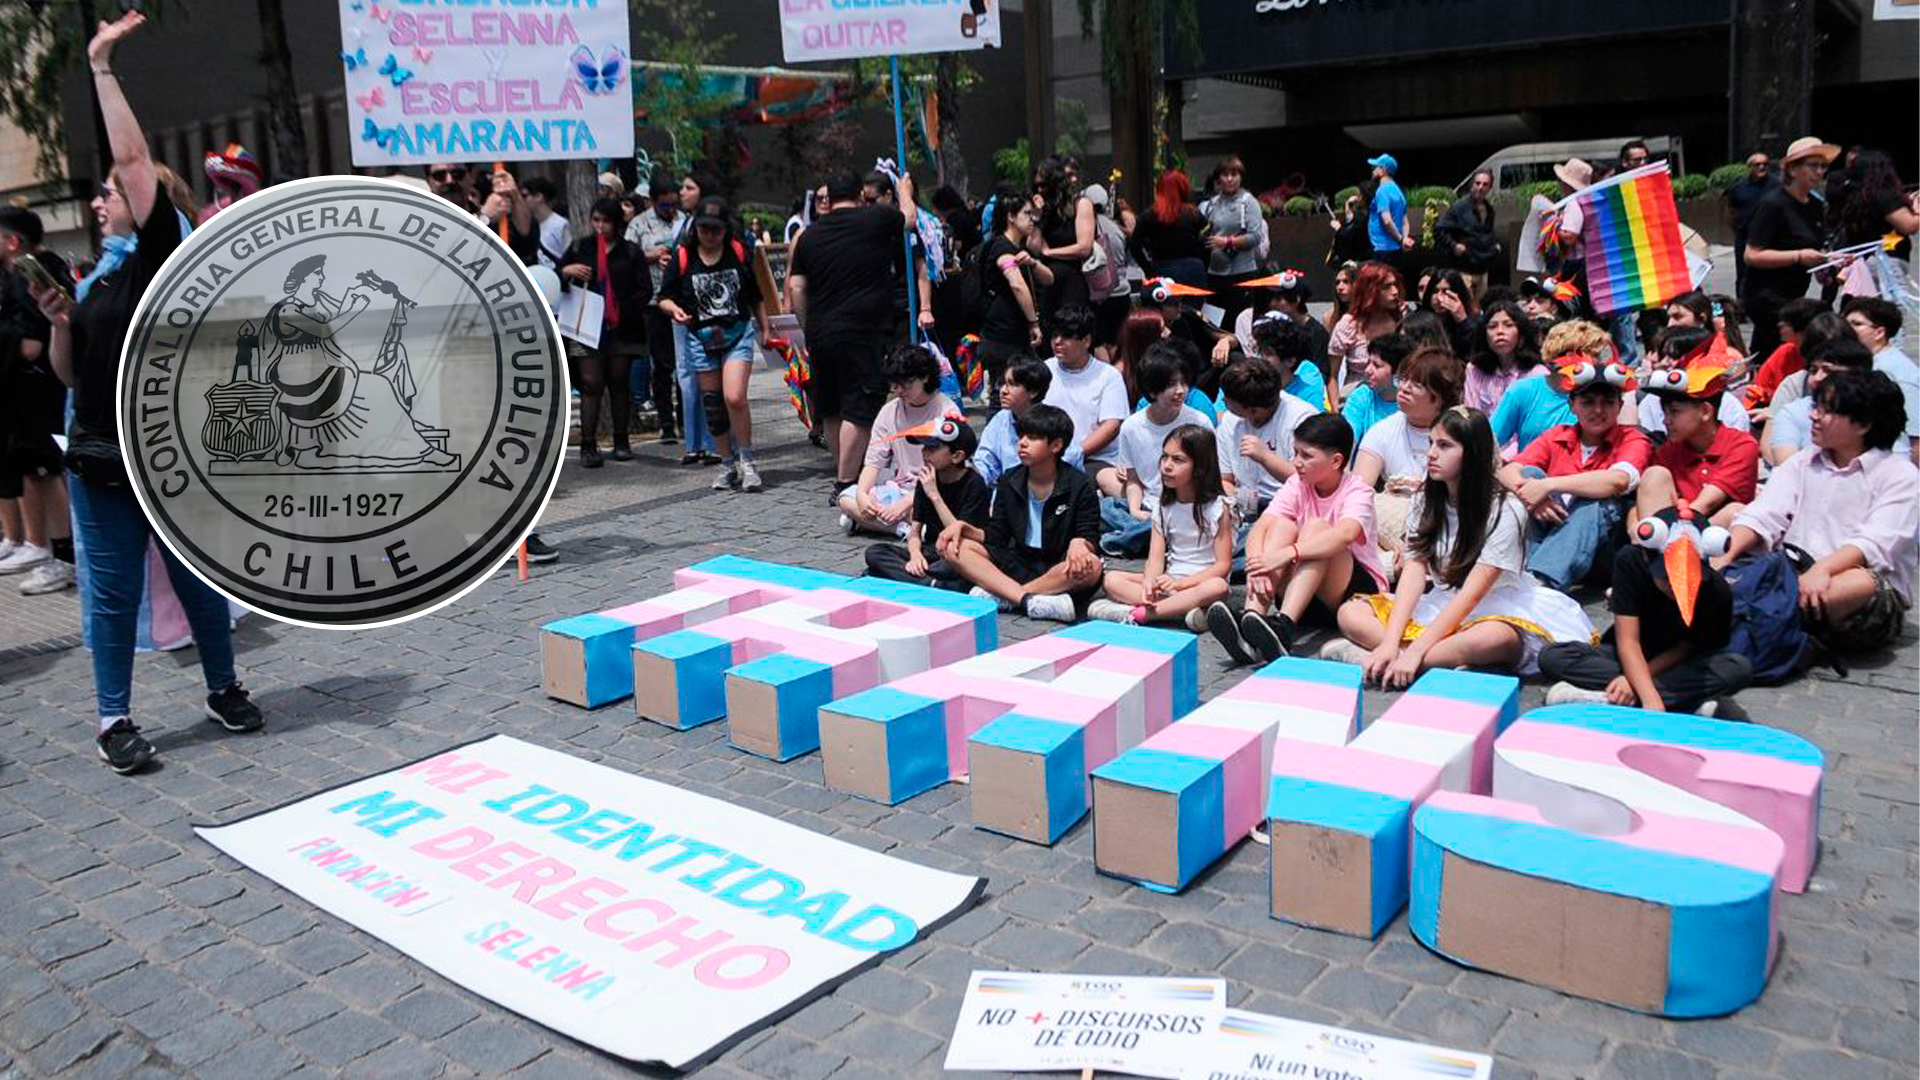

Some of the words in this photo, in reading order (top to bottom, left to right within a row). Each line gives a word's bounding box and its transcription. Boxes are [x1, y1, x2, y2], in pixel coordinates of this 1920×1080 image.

[389, 12, 579, 46] SELENNA
[803, 20, 908, 49] QUITAR
[400, 78, 583, 116] ESCUELA
[389, 118, 598, 156] AMARANTA
[402, 752, 512, 795] MI
[481, 782, 919, 954] IDENTIDAD
[329, 790, 446, 839] MI
[409, 825, 791, 991] DERECHO
[464, 920, 617, 1000] SELENNA
[977, 1008, 1016, 1026] NO
[1056, 1009, 1206, 1035] DISCURSOS
[1034, 1028, 1072, 1047] DE
[1074, 1029, 1140, 1050] ODIO
[1249, 1053, 1275, 1070] Ni
[1277, 1060, 1308, 1076] un
